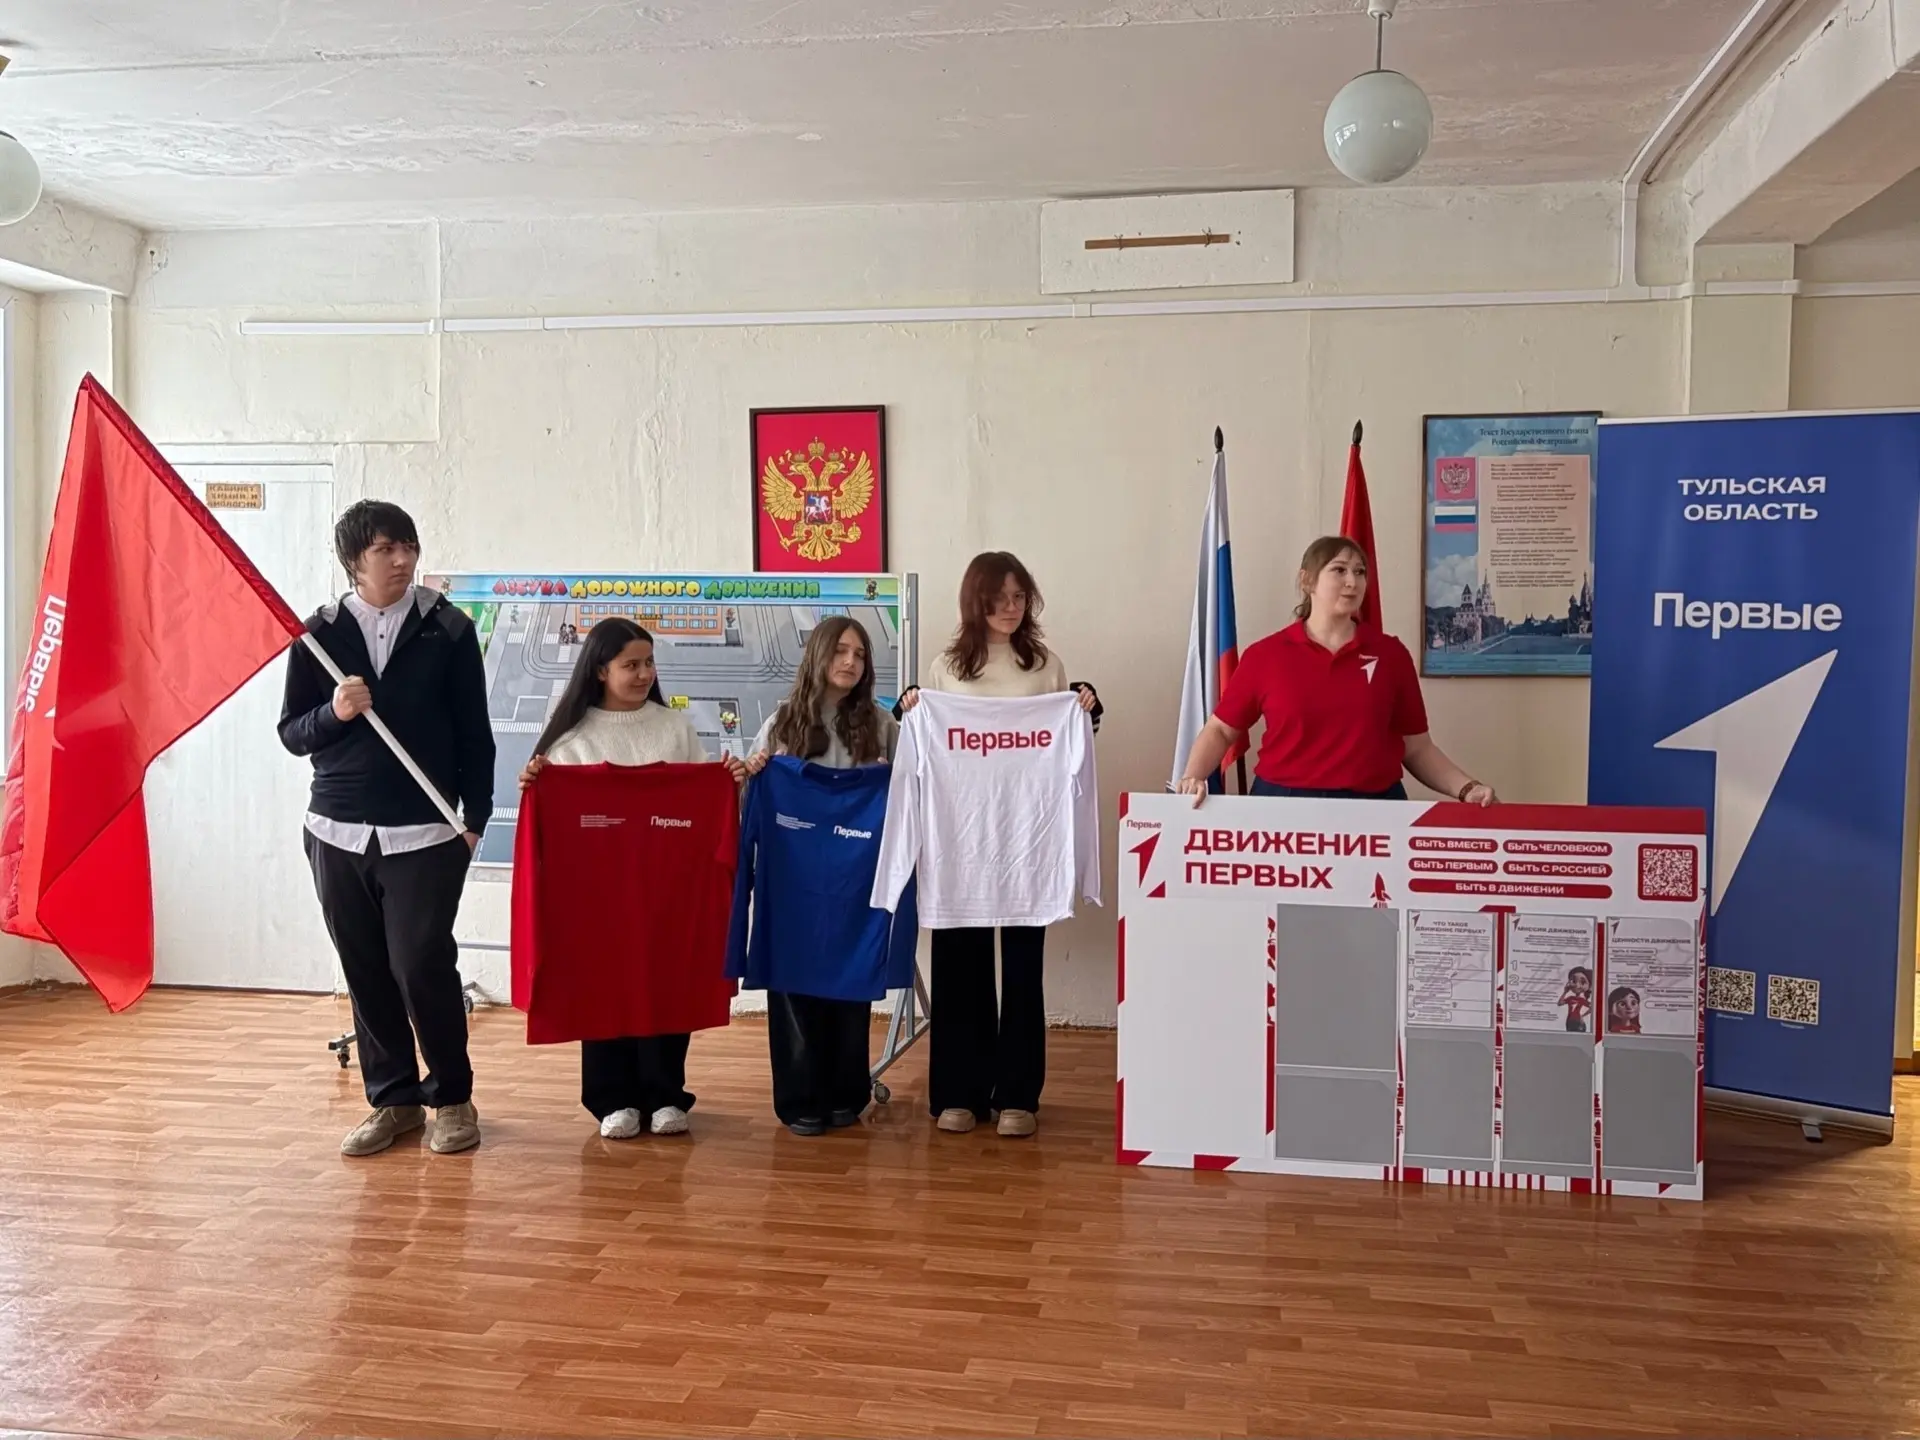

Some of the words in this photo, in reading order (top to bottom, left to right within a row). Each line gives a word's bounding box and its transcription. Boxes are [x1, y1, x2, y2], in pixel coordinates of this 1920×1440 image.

[1677, 476, 1827, 496] ТУЛЬСКАЯ
[1683, 502, 1819, 521] ОБЛАСТЬ
[492, 578, 568, 597] АЗБУКА
[569, 579, 701, 599] ДОРОЖНОГО
[704, 579, 821, 599] ДВИЖЕНИЯ
[1653, 592, 1842, 640] Первые
[948, 727, 1053, 757] Первые
[650, 815, 692, 829] Первые
[1126, 819, 1162, 831] Первые
[833, 825, 872, 839] Первые
[1184, 828, 1392, 858] ДВИЖЕНИЕ
[1415, 839, 1446, 849] БЫТЬ
[1447, 840, 1492, 850] ВМЕСТЕ
[1507, 842, 1538, 851] БЫТЬ
[1539, 843, 1608, 853] ЧЕЛОВЕКОМ
[1413, 860, 1444, 870] БЫТЬ
[1446, 861, 1493, 871] ПЕРВЫМ
[1508, 863, 1540, 873] БЫТЬ
[1541, 864, 1550, 873] С
[1551, 864, 1607, 875] РОССИЕЙ
[1185, 861, 1334, 890] ПЕРВЫХ
[1455, 882, 1487, 892] БЫТЬ
[1488, 884, 1496, 892] В
[1498, 884, 1565, 895] ДВИЖЕНИИ
